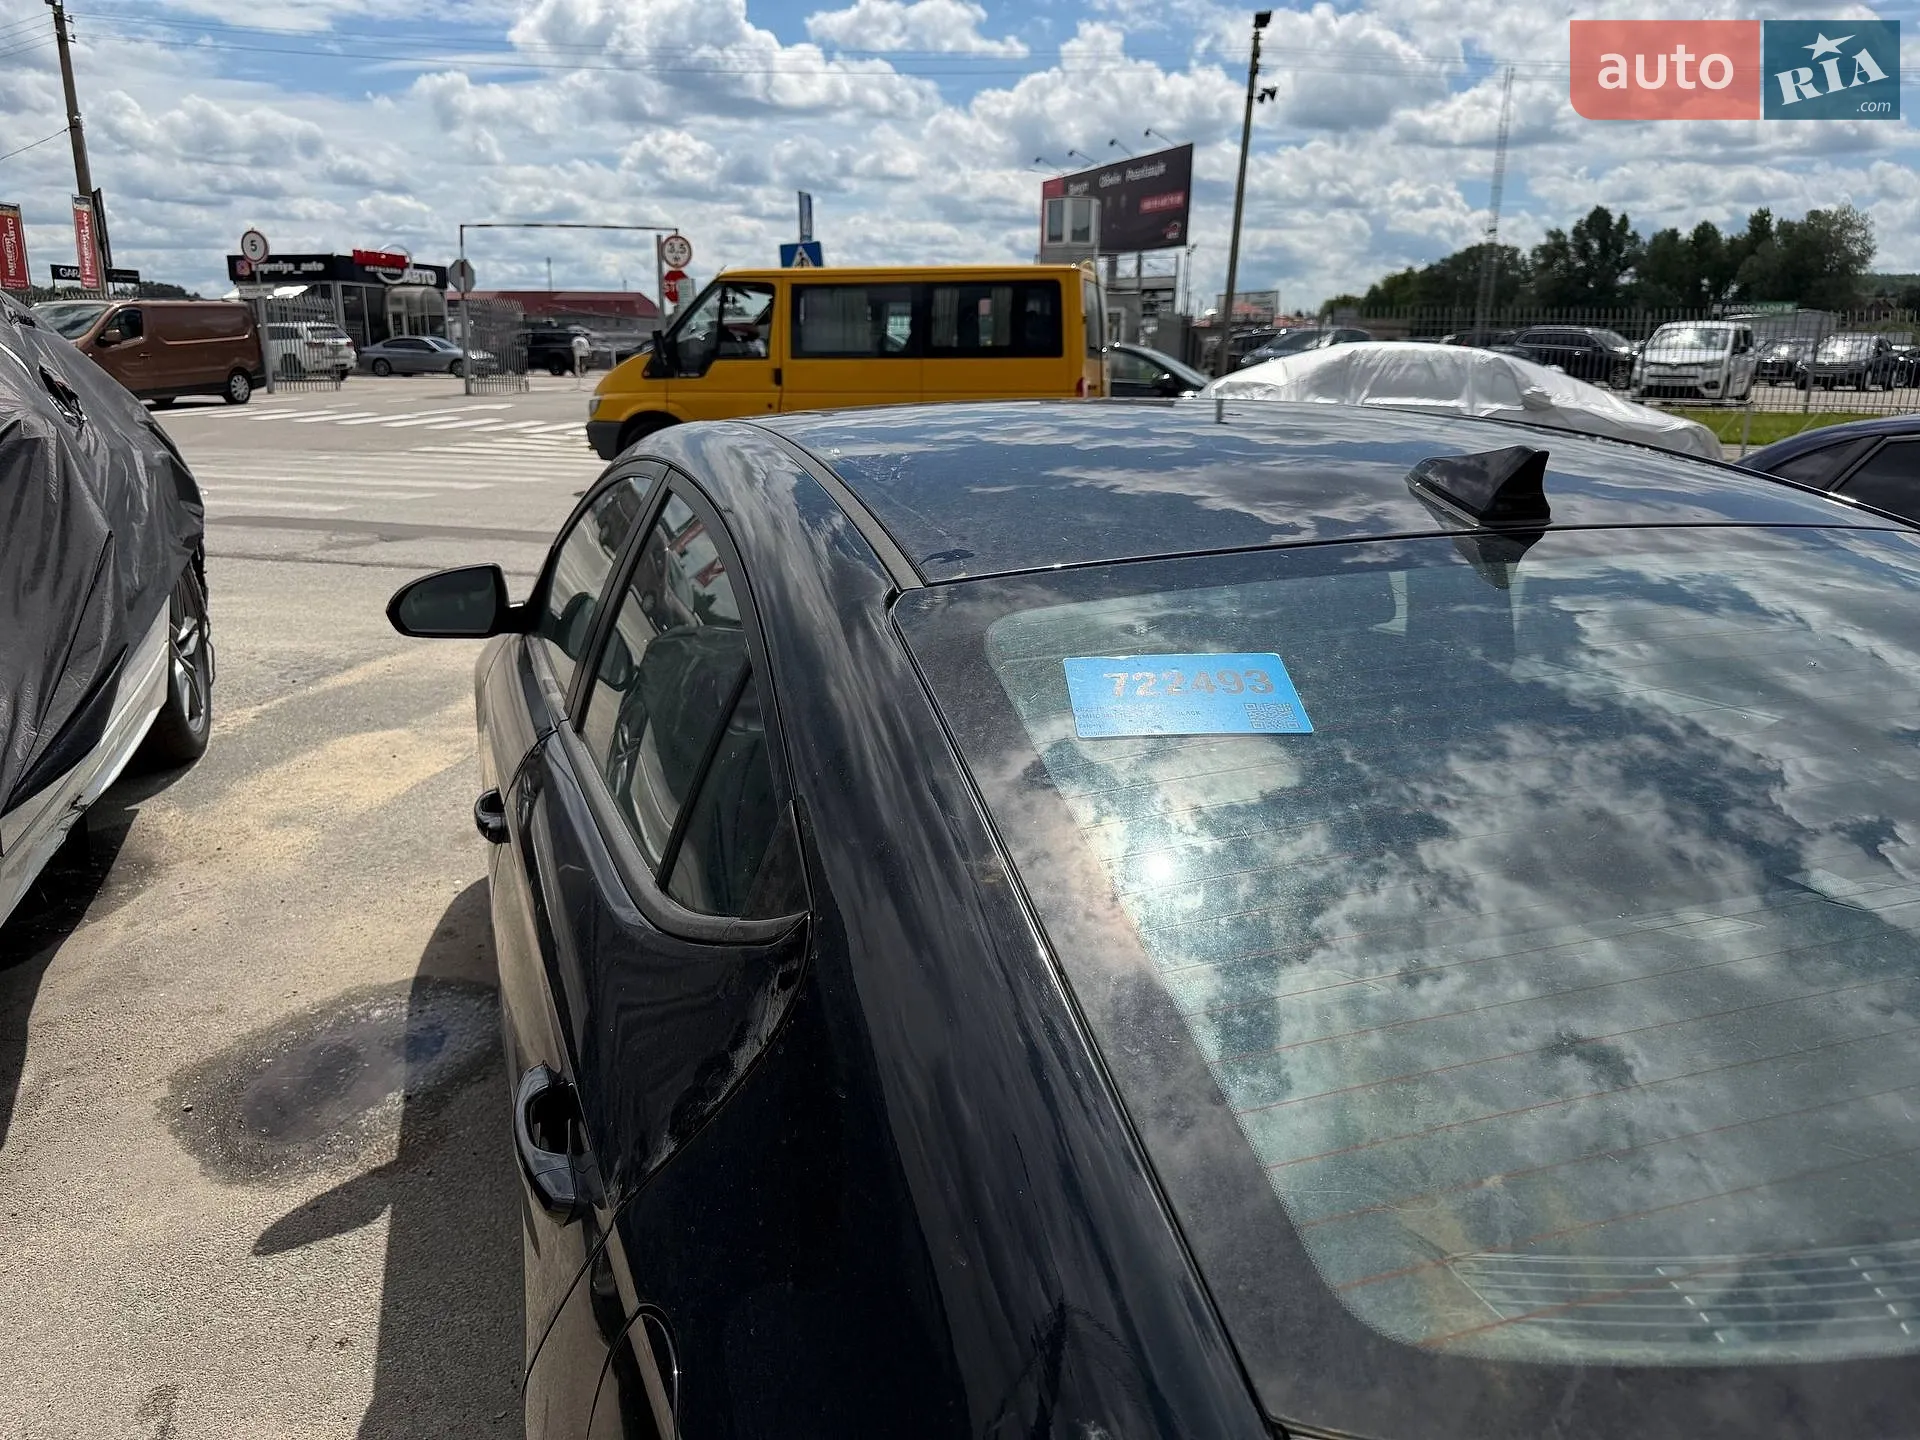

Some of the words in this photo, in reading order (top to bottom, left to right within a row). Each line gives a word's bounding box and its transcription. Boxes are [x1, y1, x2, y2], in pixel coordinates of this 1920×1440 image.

[250, 239, 258, 252] 5
[403, 268, 437, 286] АВТО
[1103, 668, 1276, 699] 722493
